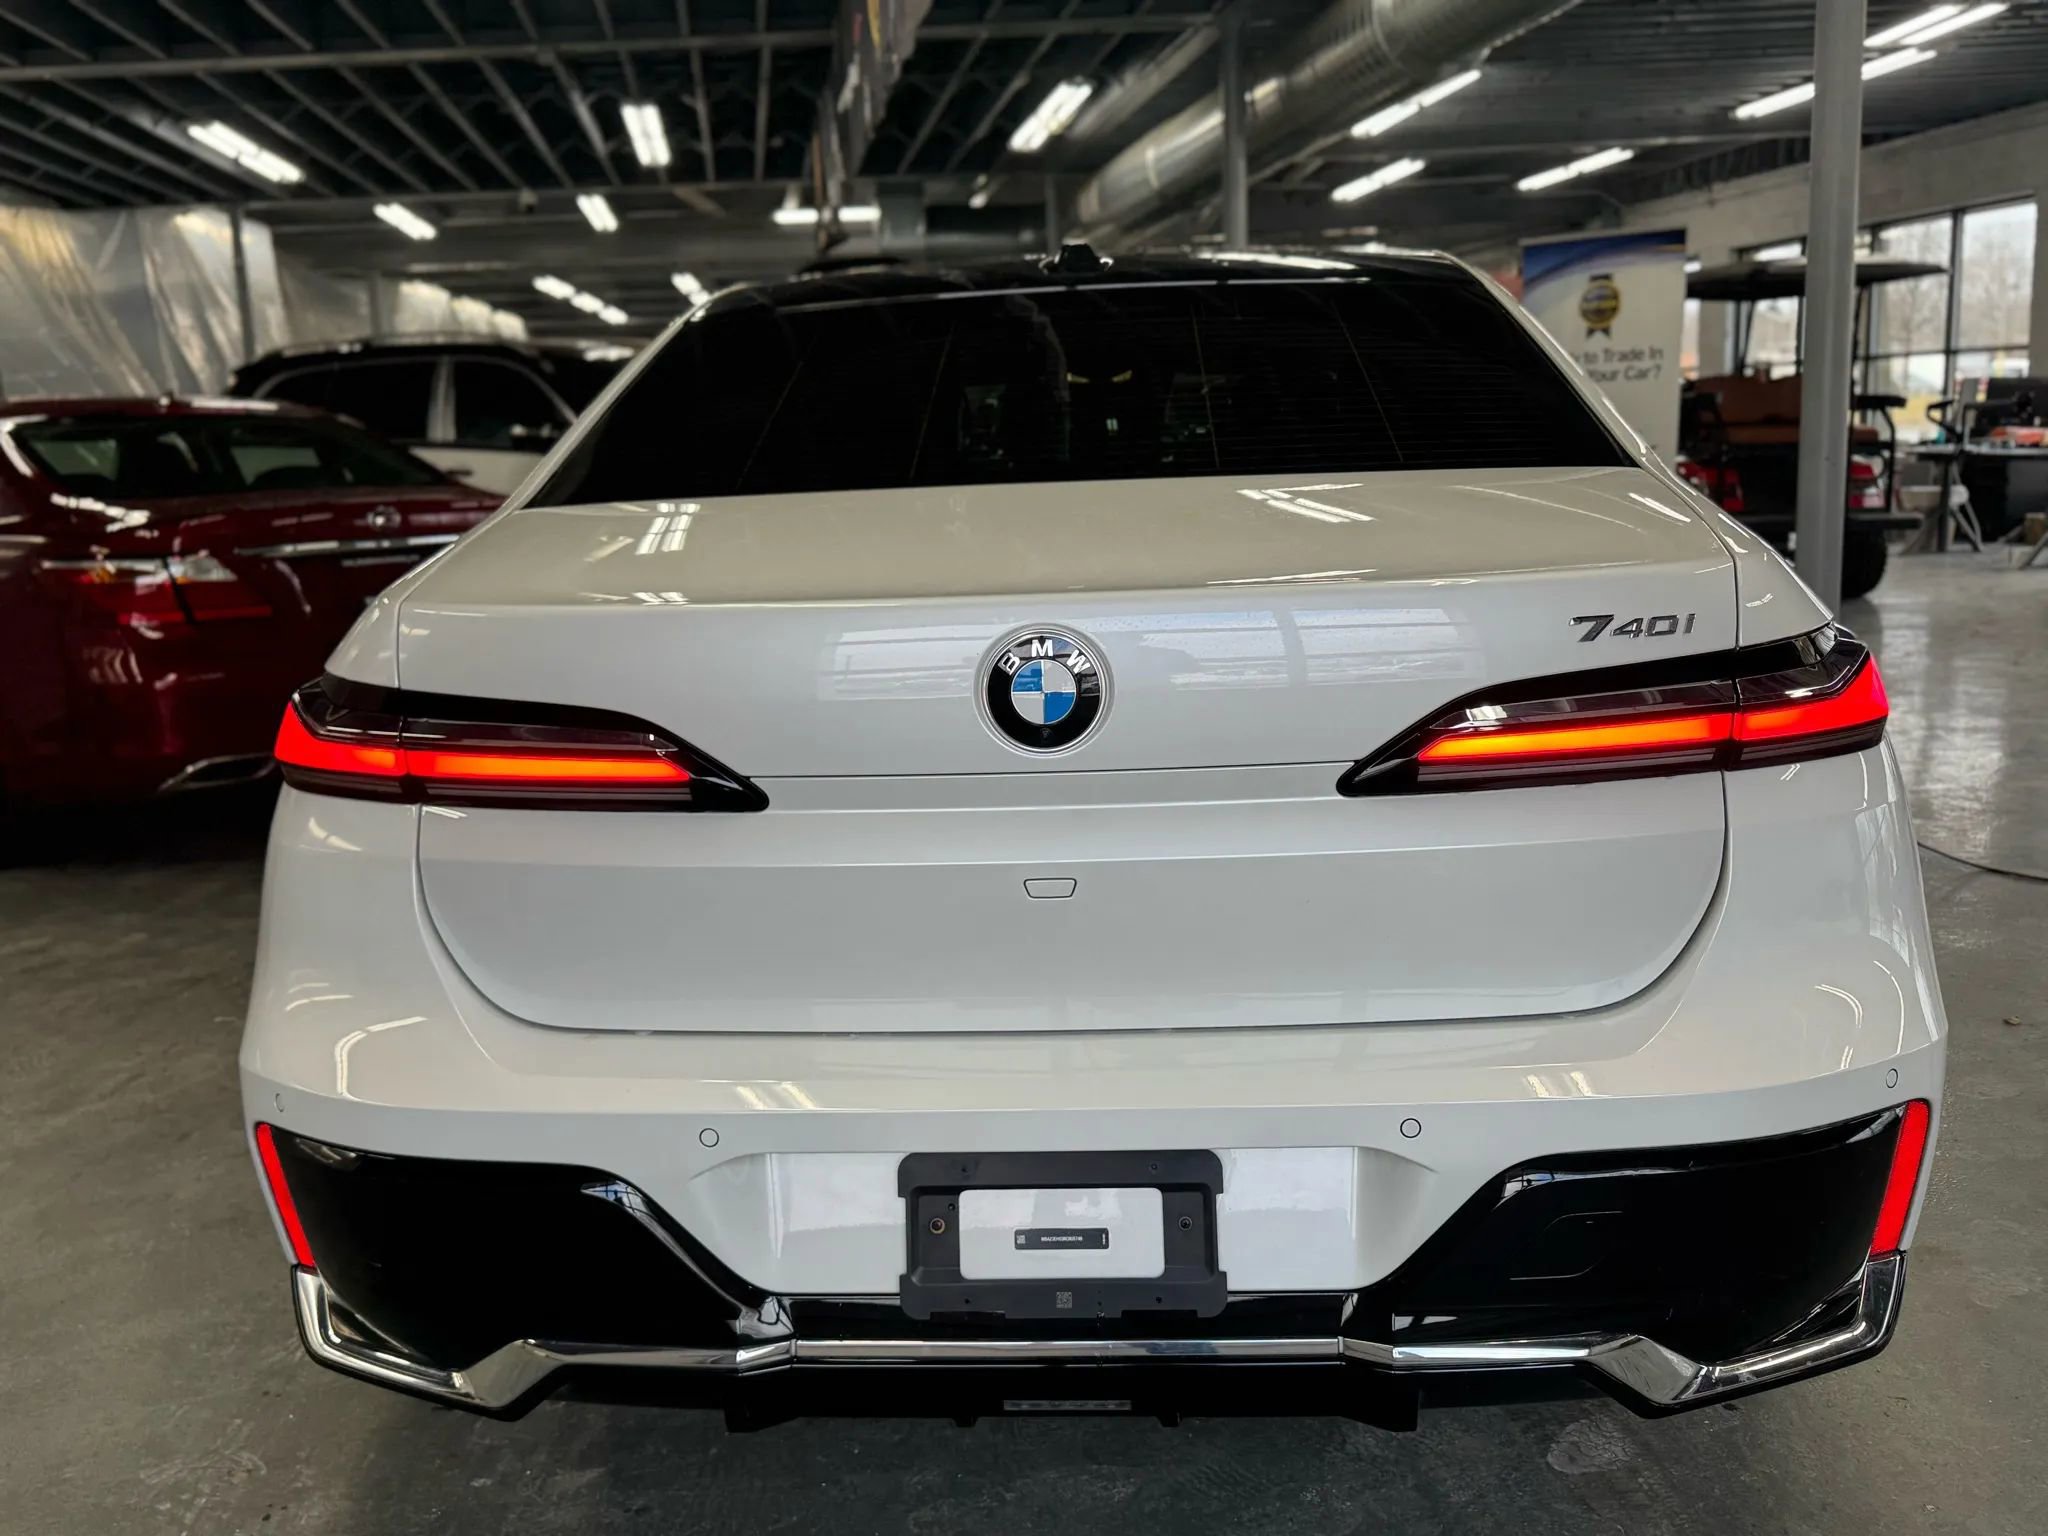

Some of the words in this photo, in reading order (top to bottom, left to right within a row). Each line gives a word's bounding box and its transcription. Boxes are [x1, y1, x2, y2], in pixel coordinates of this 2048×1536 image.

[1584, 351, 1598, 363] to
[1603, 347, 1645, 362] Trade
[1587, 368, 1619, 383] Your
[1624, 364, 1662, 381] Car?
[998, 639, 1091, 676] BMW
